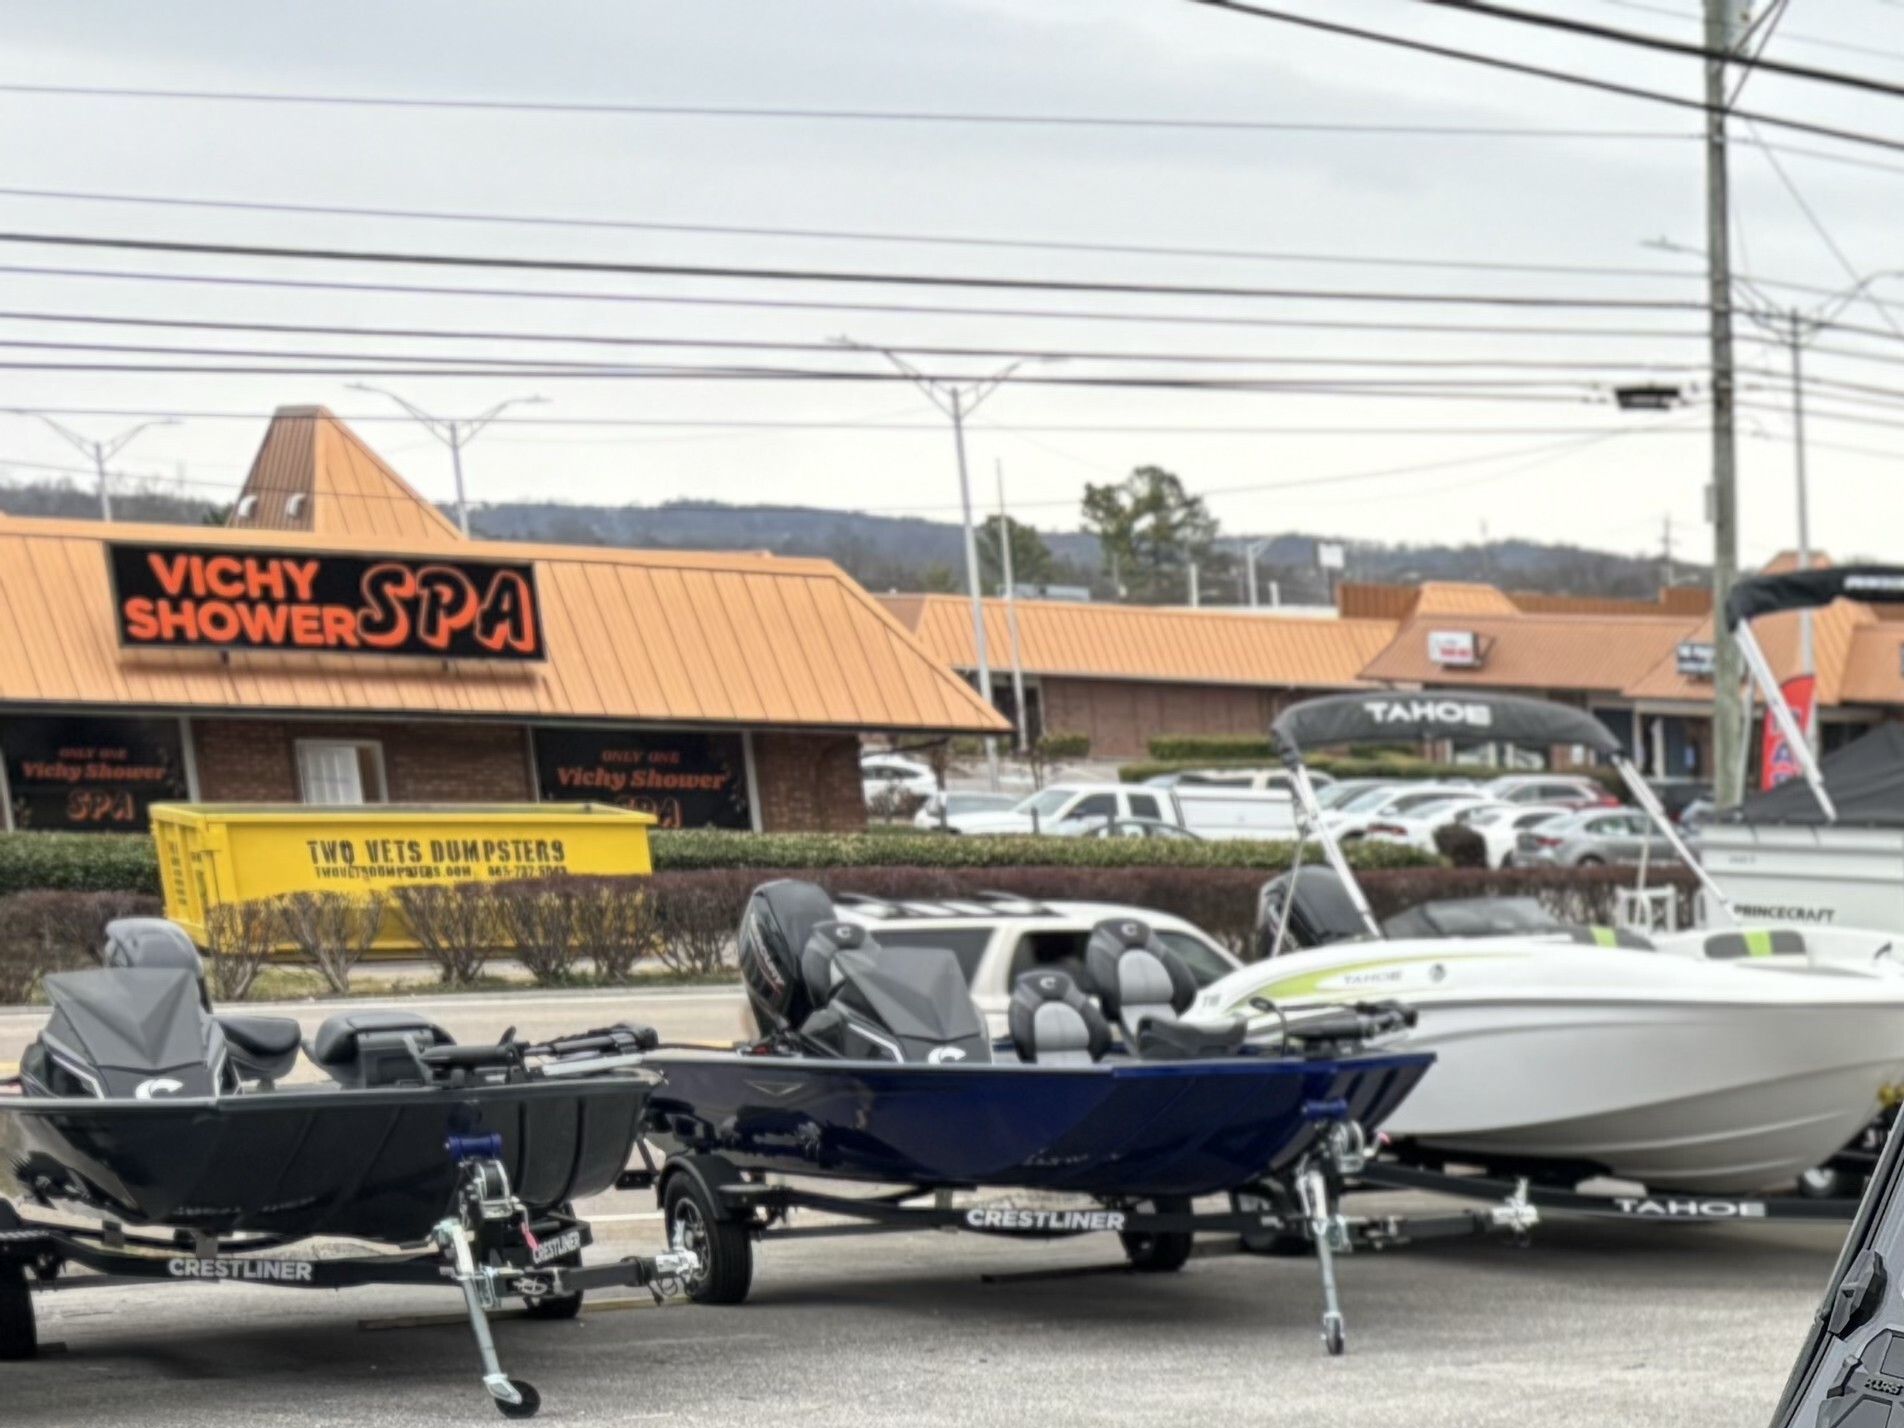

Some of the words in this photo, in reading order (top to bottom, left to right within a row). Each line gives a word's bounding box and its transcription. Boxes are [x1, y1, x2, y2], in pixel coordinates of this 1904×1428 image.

[148, 553, 319, 600] VICHY
[356, 562, 536, 652] SPA
[124, 597, 360, 646] SHOWER
[1364, 700, 1490, 726] TAHOE
[22, 763, 81, 782] Vichy
[85, 765, 165, 780] Shower
[557, 767, 627, 791] Vichy
[630, 768, 727, 789] Shower
[67, 788, 136, 821] SPA
[306, 840, 355, 864] TWO
[365, 839, 422, 863] VETS
[430, 839, 565, 863] DUMPSTERS
[1734, 904, 1836, 922] PRINCECRAFT
[967, 1208, 1126, 1230] CRESTLINER
[1613, 1199, 1766, 1218] TAHOE
[532, 1231, 581, 1264] CRESTLINER
[168, 1257, 313, 1281] CRESTLINER
